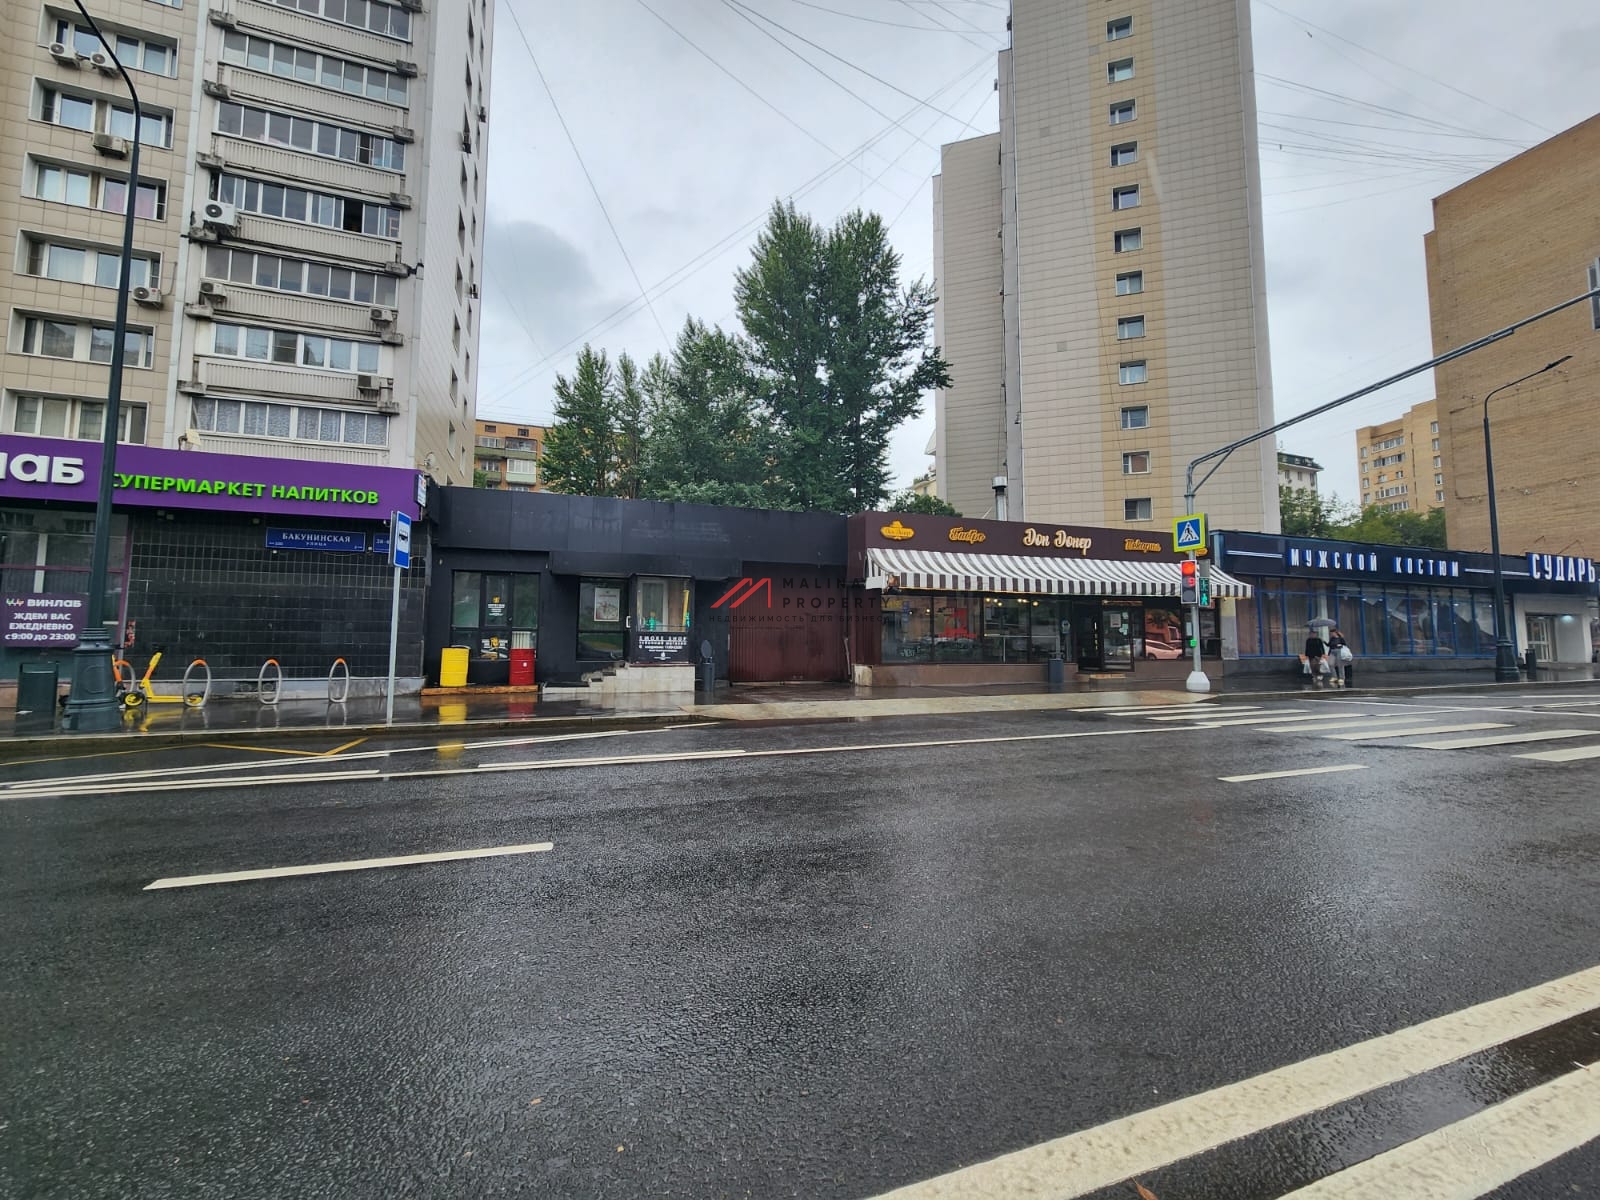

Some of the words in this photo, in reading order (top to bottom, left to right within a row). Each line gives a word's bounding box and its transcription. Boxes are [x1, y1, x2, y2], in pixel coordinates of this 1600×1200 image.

[271, 484, 379, 505] НАПИТКОВ
[282, 533, 351, 543] БАКУНИНСКАЯ
[1023, 528, 1050, 546] Дон
[1054, 530, 1092, 555] Донер
[1289, 548, 1377, 571] МУЖСКОЙ
[1394, 556, 1459, 577] КОСТЮМ
[1531, 554, 1596, 583] СУДАРЬ
[14, 613, 48, 621] ЖДЕМ
[9, 622, 74, 631] ЕЖЕДНЕВНО
[50, 633, 76, 641] 23:00
